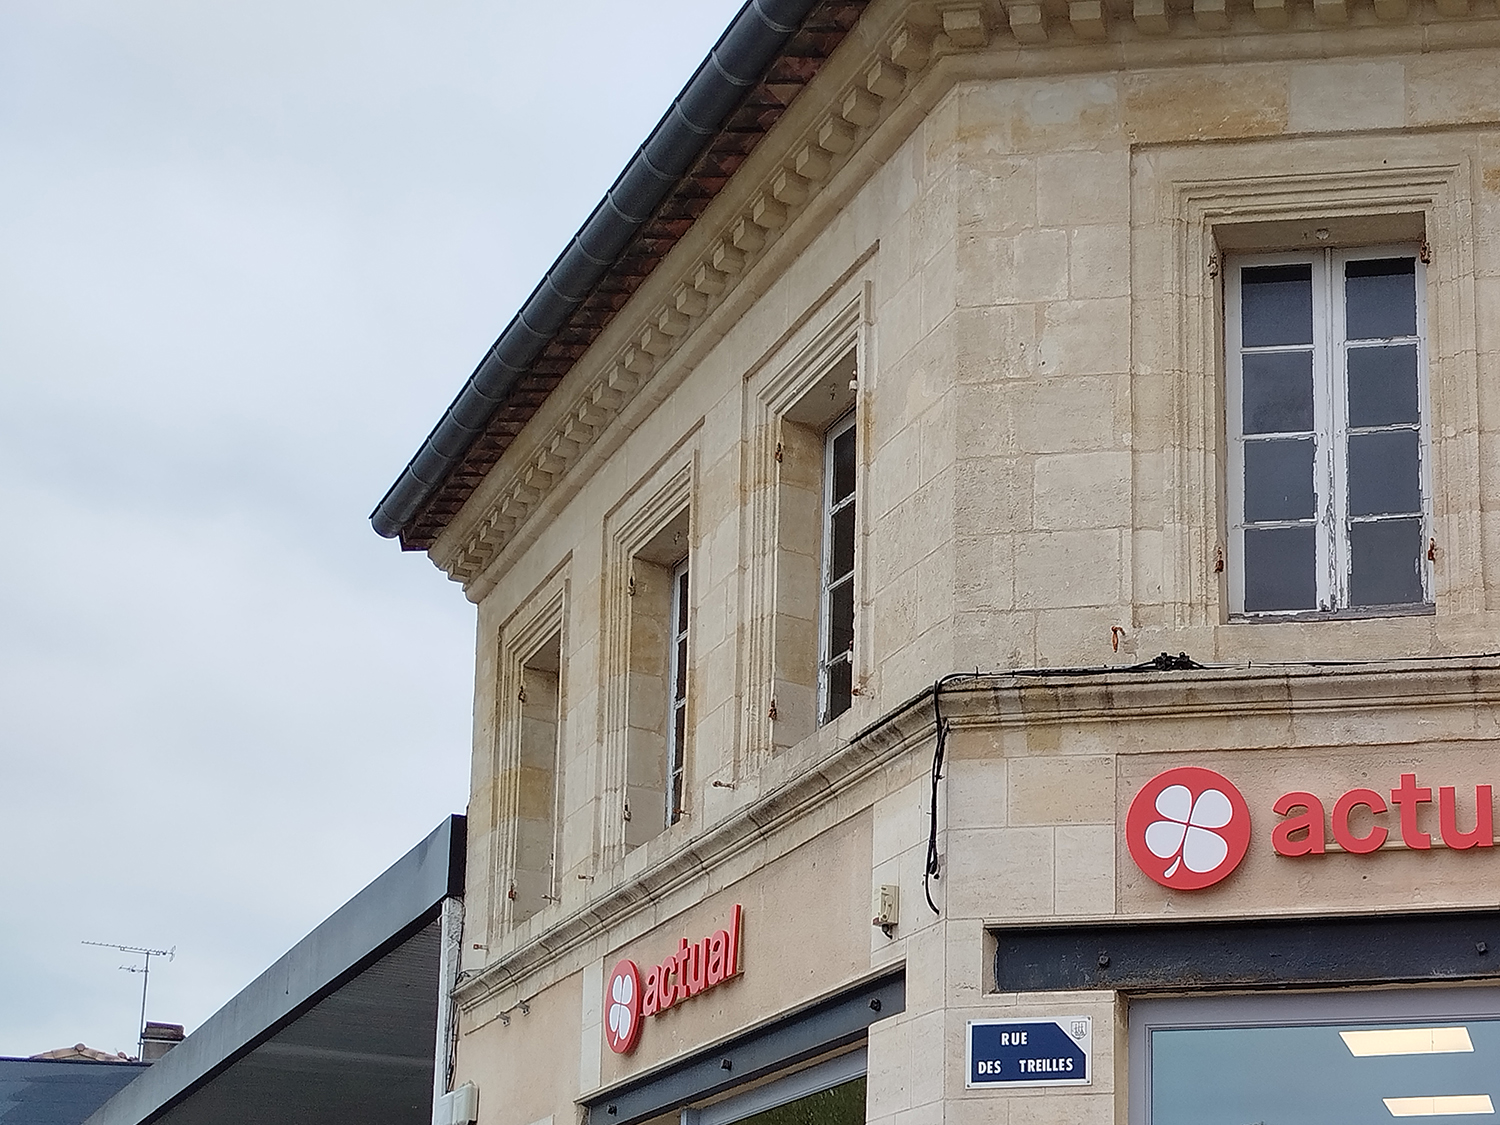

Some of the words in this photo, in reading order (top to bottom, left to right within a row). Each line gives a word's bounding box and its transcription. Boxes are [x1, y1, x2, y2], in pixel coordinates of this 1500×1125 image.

[643, 904, 742, 1016] actual
[1001, 1032, 1028, 1046] RUE
[978, 1060, 1002, 1074] DES
[1018, 1058, 1073, 1073] TREILLES
